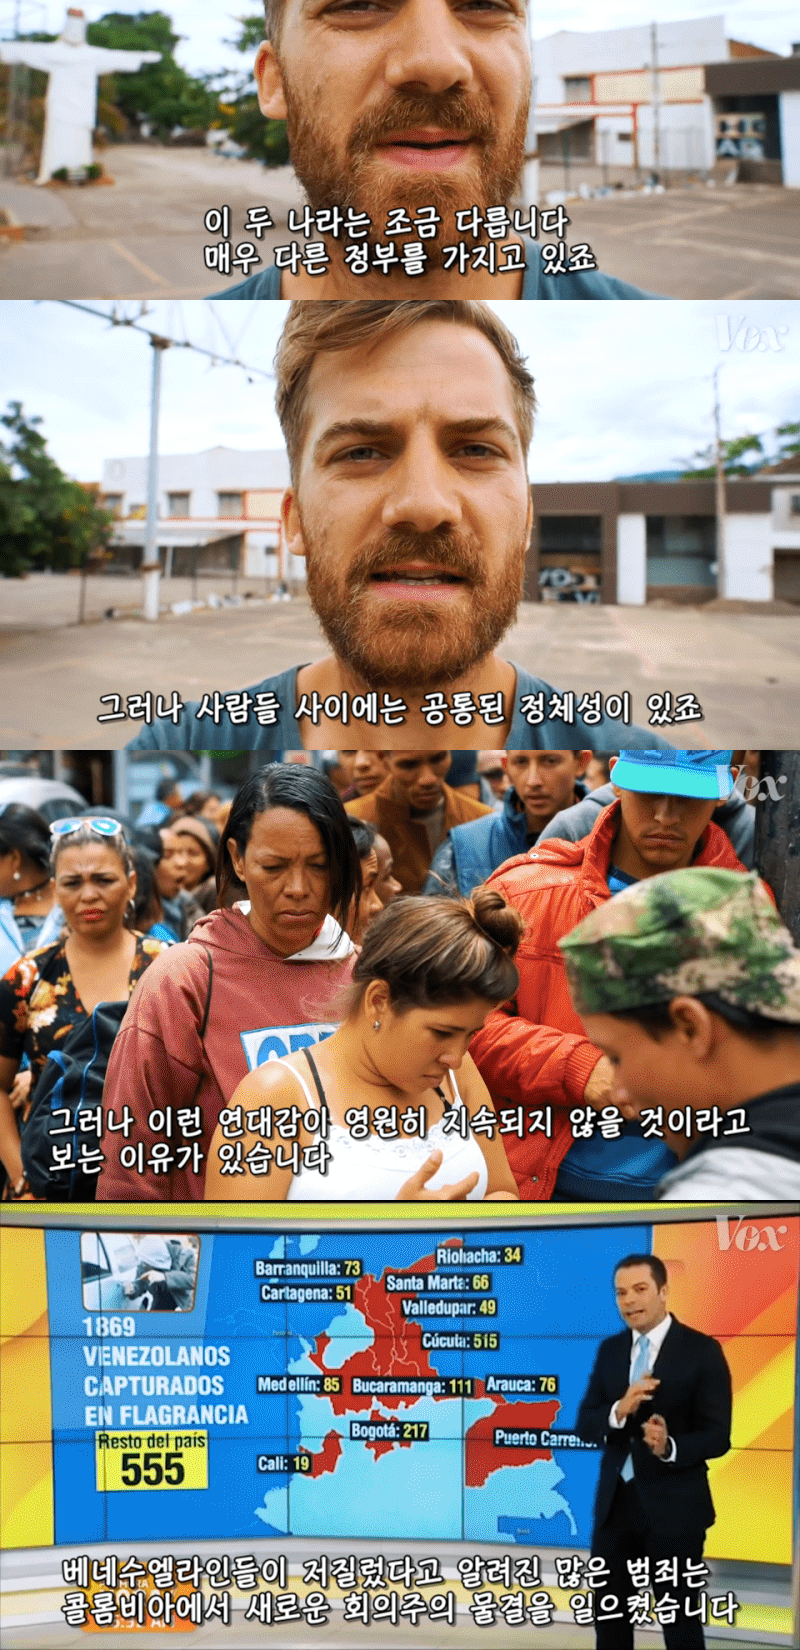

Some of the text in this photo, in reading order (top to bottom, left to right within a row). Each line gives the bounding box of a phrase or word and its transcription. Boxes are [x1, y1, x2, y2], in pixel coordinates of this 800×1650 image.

[436, 1247, 521, 1265] Riohacha: 34
[255, 1260, 361, 1279] Barranquilla: 73
[386, 1274, 489, 1291] Santa Marta: 66
[261, 1285, 352, 1303] Cartagena: 51
[402, 1299, 496, 1318] Valledupar: 49
[82, 1316, 136, 1337] 1869
[422, 1332, 498, 1349] Cúcuta: 515
[82, 1345, 231, 1367] VENEZOLANOS
[84, 1375, 225, 1397] CAPTURADOS
[257, 1376, 340, 1393] Medellín: 85
[352, 1378, 472, 1397] Bucaramanga: 111
[486, 1376, 556, 1392] Arauca: 76
[85, 1404, 249, 1427] EN FLAGRANCIA
[351, 1421, 428, 1440] Bogotá: 217
[494, 1430, 537, 1446] Puerto
[98, 1431, 206, 1451] Resto del país
[121, 1452, 185, 1487] 555
[257, 1456, 310, 1471] Cali: 19
